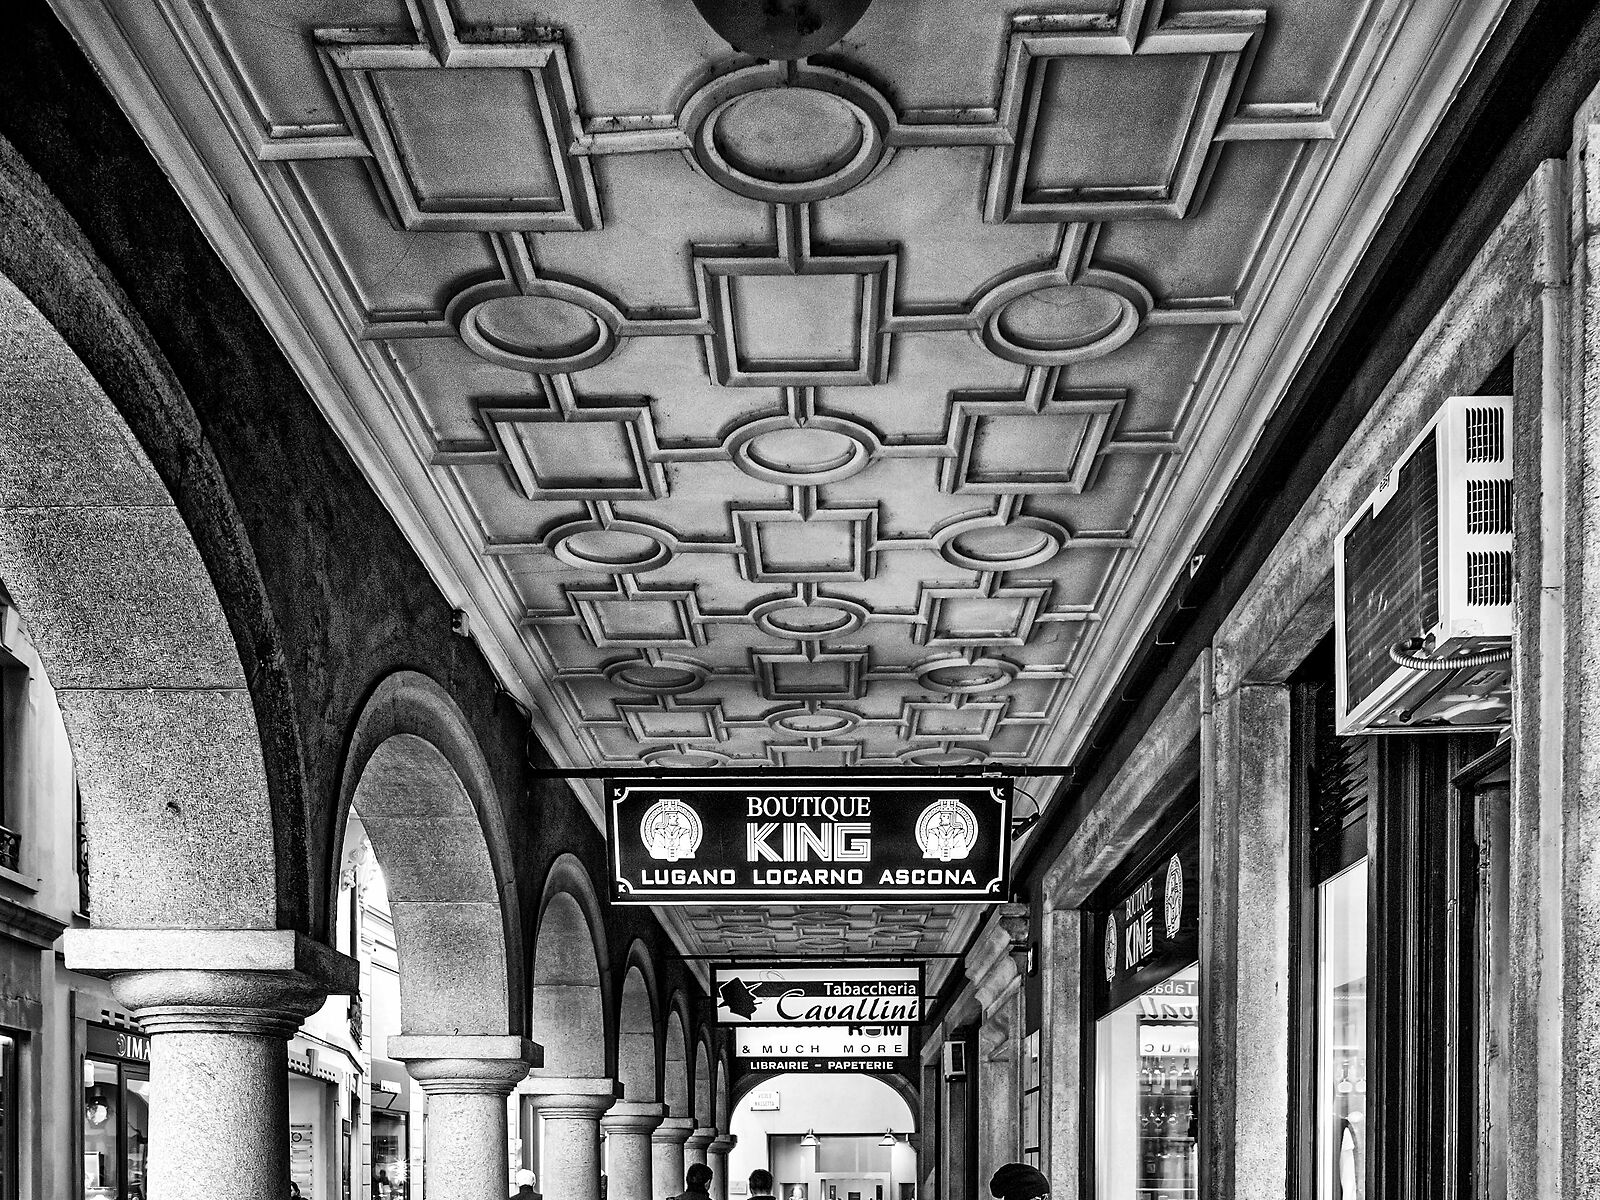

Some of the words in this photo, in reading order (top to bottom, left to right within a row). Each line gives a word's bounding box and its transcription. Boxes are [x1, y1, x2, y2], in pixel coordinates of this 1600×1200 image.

[614, 788, 622, 797] K
[996, 788, 1004, 797] K
[746, 796, 872, 821] BOUTIQUE
[746, 822, 871, 862] KING
[641, 869, 736, 885] LUGANO
[753, 869, 863, 885] LOCARNO
[878, 869, 977, 885] ASCONA
[618, 884, 627, 893] K
[992, 884, 1000, 893] K
[1125, 907, 1153, 970] KING
[823, 982, 916, 996] Tabaccheria
[776, 988, 919, 1021] Cavallini
[742, 1045, 750, 1054] &
[762, 1045, 820, 1054] MUCH
[843, 1044, 903, 1053] MORE
[750, 1061, 809, 1070] LIBRAIRIE
[827, 1061, 894, 1070] PAPETERIE
